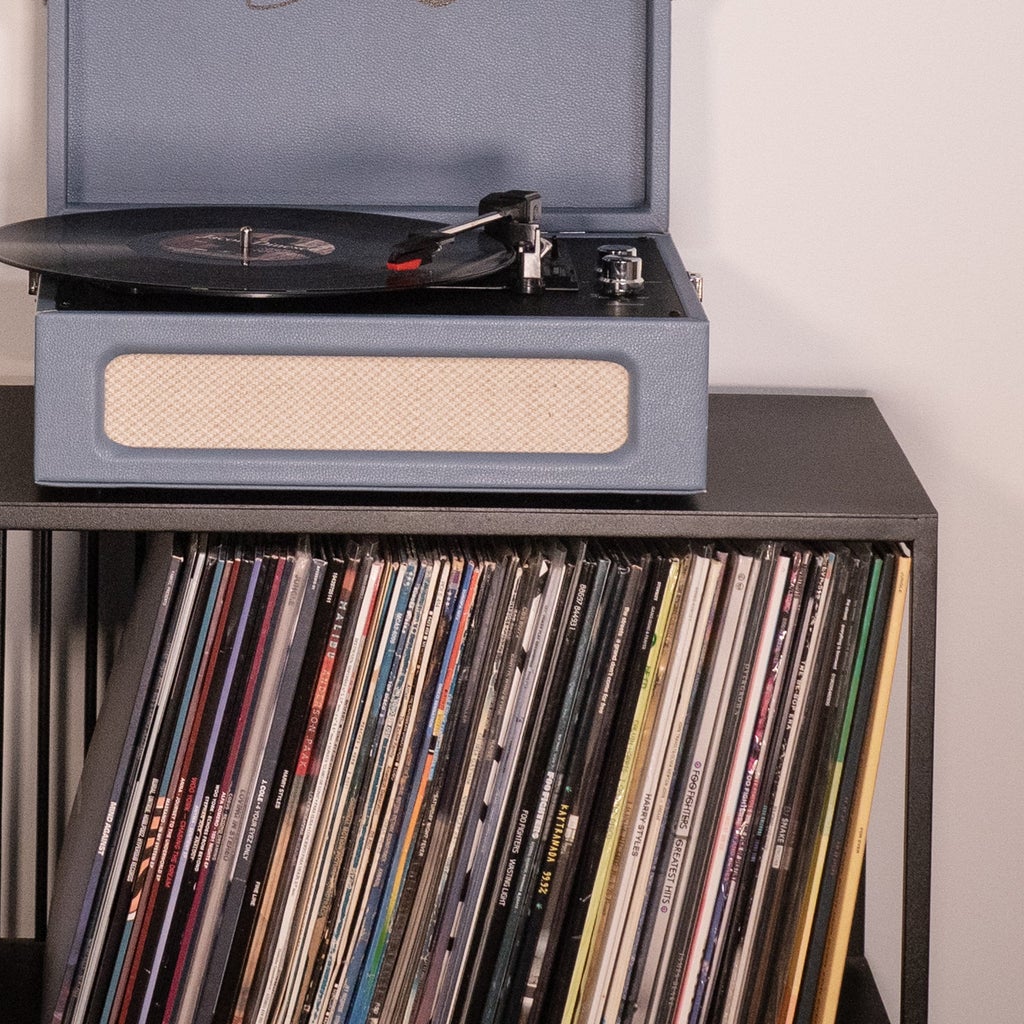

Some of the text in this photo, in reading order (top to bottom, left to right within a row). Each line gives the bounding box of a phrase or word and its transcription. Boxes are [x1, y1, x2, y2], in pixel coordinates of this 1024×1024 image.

[325, 600, 347, 659] MALIBU
[617, 616, 627, 636] streets
[609, 643, 619, 661] grand
[607, 660, 616, 676] don't
[603, 676, 611, 692] come
[306, 668, 330, 733] ANDERSON
[600, 692, 608, 702] for
[786, 660, 805, 730] THE BE-BOP ERA
[597, 702, 605, 714] free
[177, 777, 185, 793] ANNA
[274, 769, 288, 808] HARRY STYLES
[542, 770, 555, 791] FOO
[256, 784, 266, 801] COLE
[170, 796, 180, 819] JOURNEY
[208, 797, 216, 812] YORK
[530, 790, 549, 840] FIGHTERS
[96, 801, 116, 856] MIND AGAINST
[202, 815, 212, 835] ECHOES
[222, 789, 245, 861] LOVING IN STEREO
[250, 809, 259, 827] YOUR
[630, 792, 652, 857] HARRY STYLES
[164, 776, 197, 888] WOO YORK CHASING THE DREAM
[246, 827, 255, 843] EYEZ
[422, 821, 431, 838] NIGHT
[661, 769, 700, 904] FOO FIGHTERS GREATEST HITS
[776, 817, 788, 843] SNAKE
[199, 835, 207, 850] FROM
[204, 842, 213, 860] NIGHTS
[241, 843, 251, 860] ONLY
[417, 839, 427, 857] FEVER
[537, 803, 569, 895] KAYTRANADA 99.9%
[157, 838, 170, 873] UNDERWORLD
[193, 850, 203, 872] BEYOND
[497, 808, 529, 906] FOO FIGHTERS WASTING LIGHT
[249, 881, 260, 906] FINE LINE
